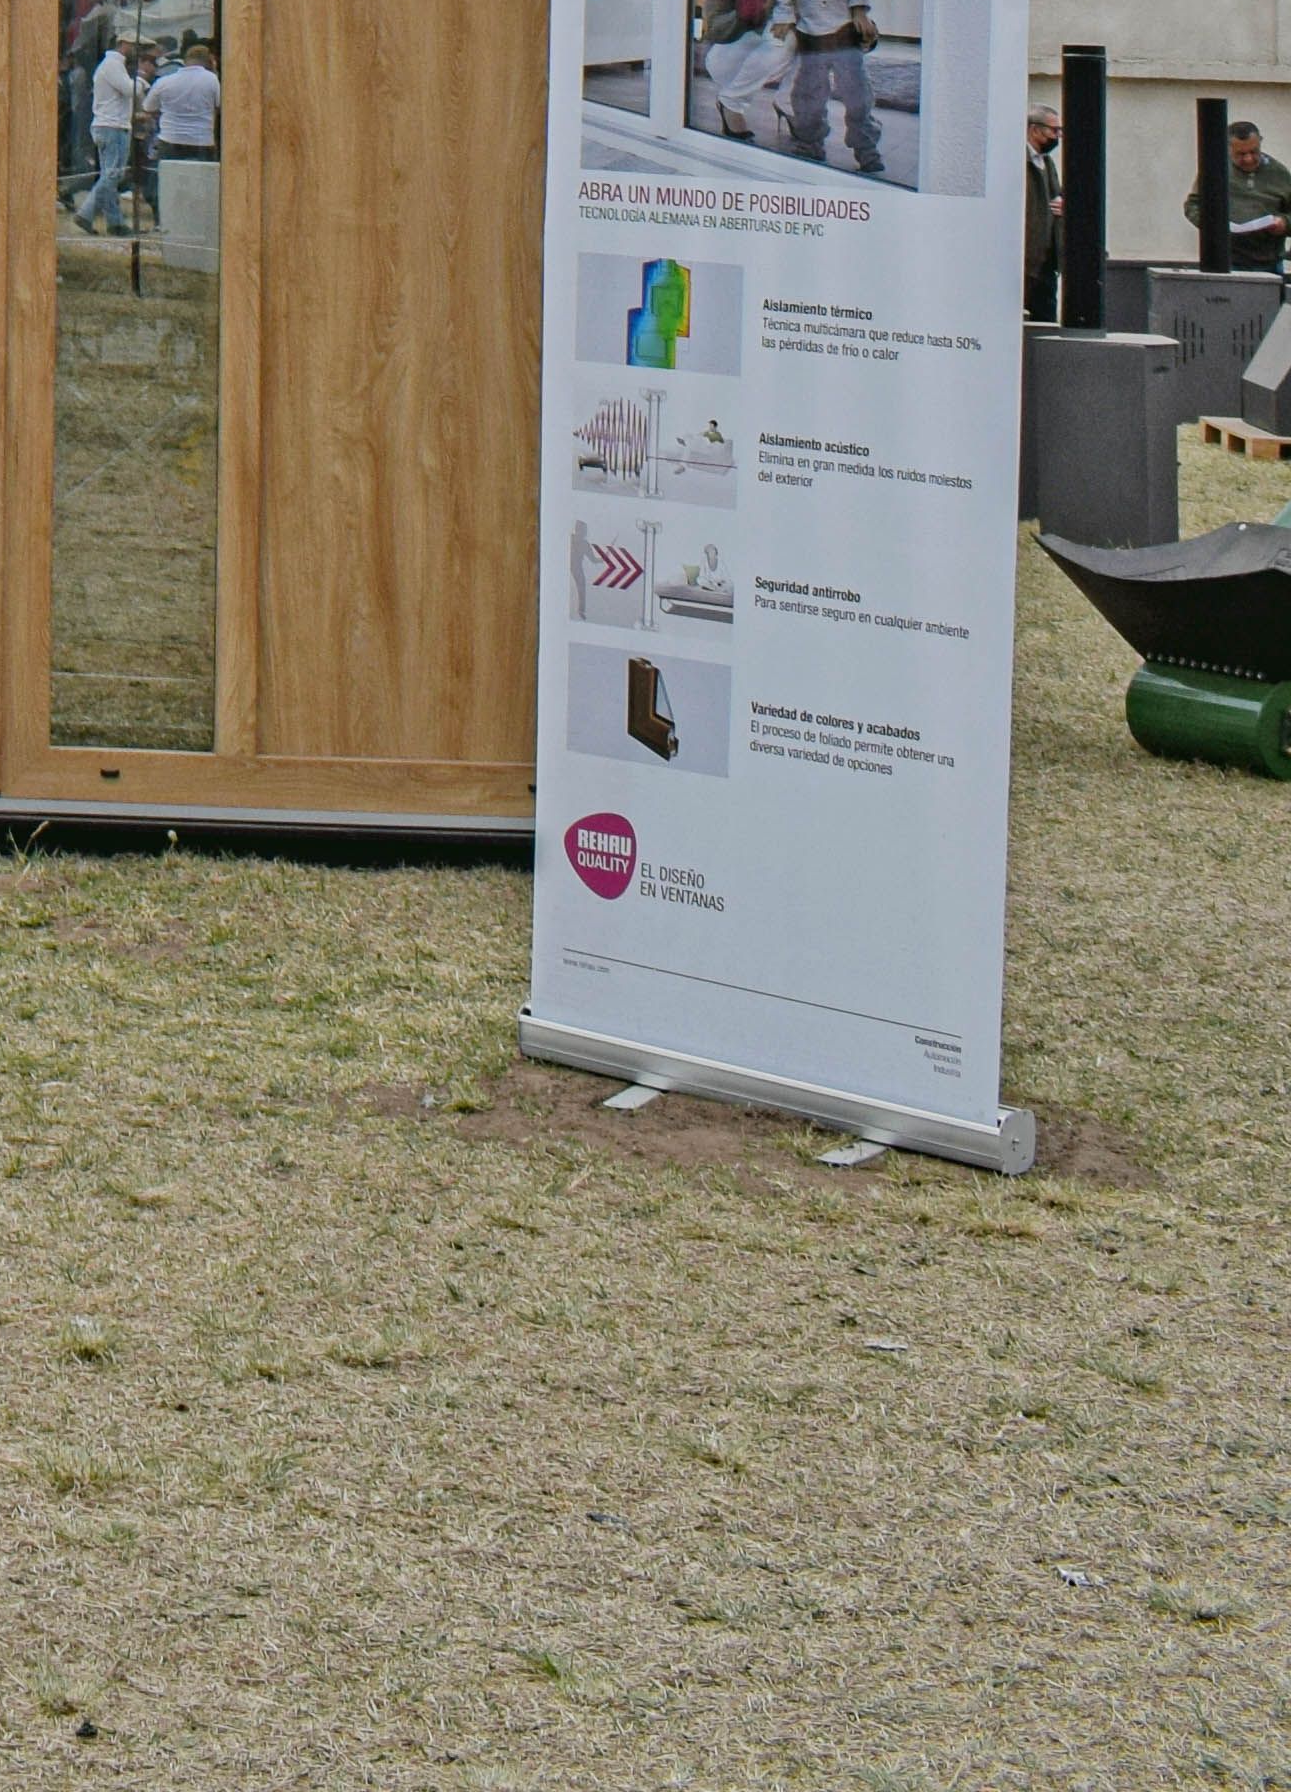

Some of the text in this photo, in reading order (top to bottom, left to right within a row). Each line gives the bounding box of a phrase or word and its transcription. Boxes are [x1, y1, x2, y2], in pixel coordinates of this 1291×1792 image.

[578, 181, 870, 222] ABRA UN MUNDO DE POSIBILIDADES
[579, 205, 824, 237] TECNOLOGÍA ALEMANA EN ABERTURAS DE PVC
[762, 298, 873, 321] Aislamiento térmico
[761, 335, 776, 349] las
[827, 341, 839, 356] de
[862, 348, 869, 359] o
[872, 346, 900, 361] calor
[763, 317, 801, 333] Técnica
[869, 329, 889, 343] que
[892, 330, 924, 345] reduce
[927, 333, 953, 348] hasta
[955, 336, 982, 351] 50%
[759, 432, 870, 457] Aislamiento acústico
[758, 450, 972, 490] Elimina en gran medida los ruidos molestos
[758, 469, 814, 487] del exterior
[755, 576, 861, 603] Seguridad antirrobo
[754, 594, 969, 640] Para sentirse seguro en cualquier ambiente
[751, 701, 920, 742] Variedad de colores y acabados
[750, 719, 955, 768] El proceso de foliado permite obtener una
[750, 739, 893, 776] diversa variedad de opciones
[577, 828, 632, 857] REHAU
[577, 850, 630, 874] QUALITY
[640, 862, 705, 889] EL DISEÑO
[639, 881, 725, 913] EN VENTANAS
